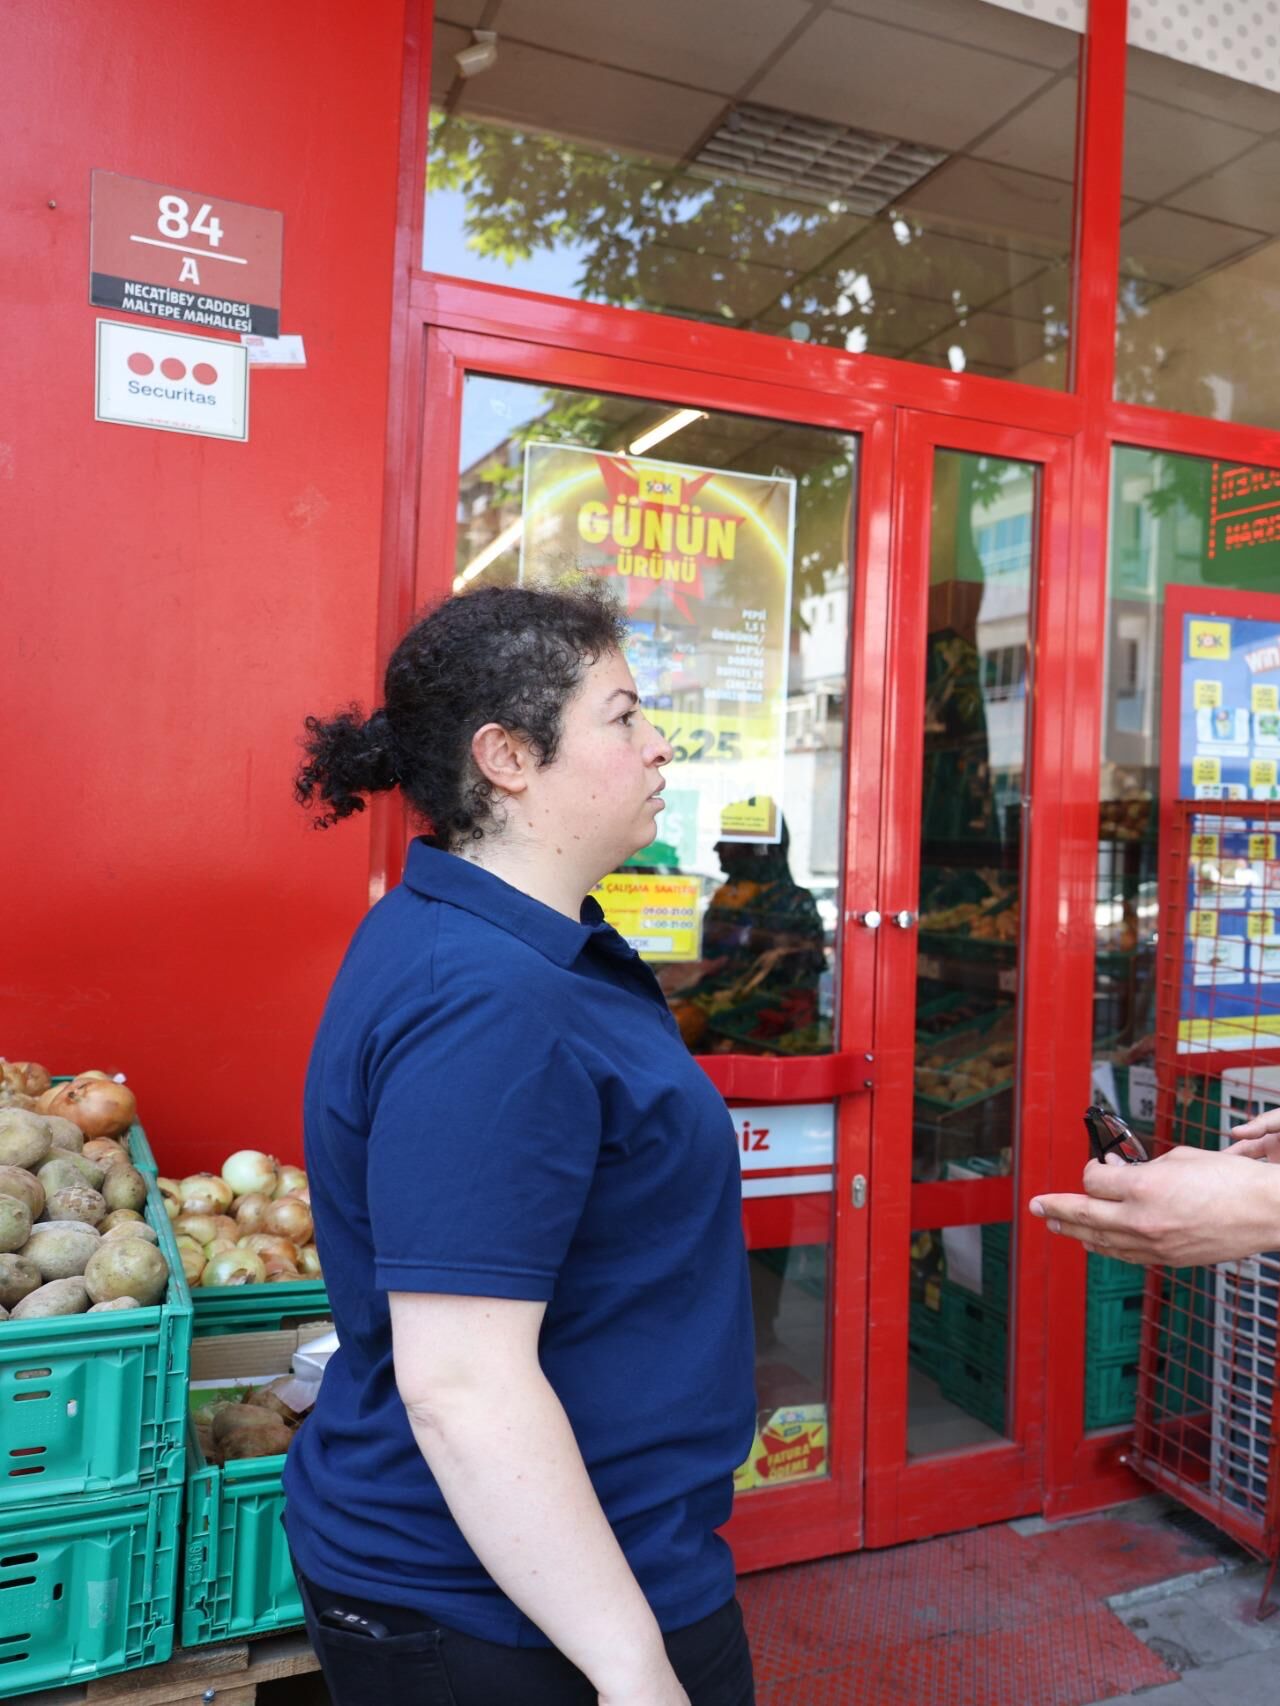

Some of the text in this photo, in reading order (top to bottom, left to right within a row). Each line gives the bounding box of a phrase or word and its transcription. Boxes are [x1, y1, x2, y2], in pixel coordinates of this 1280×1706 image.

[157, 195, 224, 247] 84
[178, 257, 200, 285] A
[121, 297, 252, 333] MALTEPE MAHALLESİ
[124, 282, 250, 318] NECATİBEY CADDESİ
[127, 380, 217, 406] Securitas
[578, 494, 737, 560] GÜNÜN
[617, 548, 697, 583] ÜRÜNÜ
[735, 1121, 770, 1152] iz
